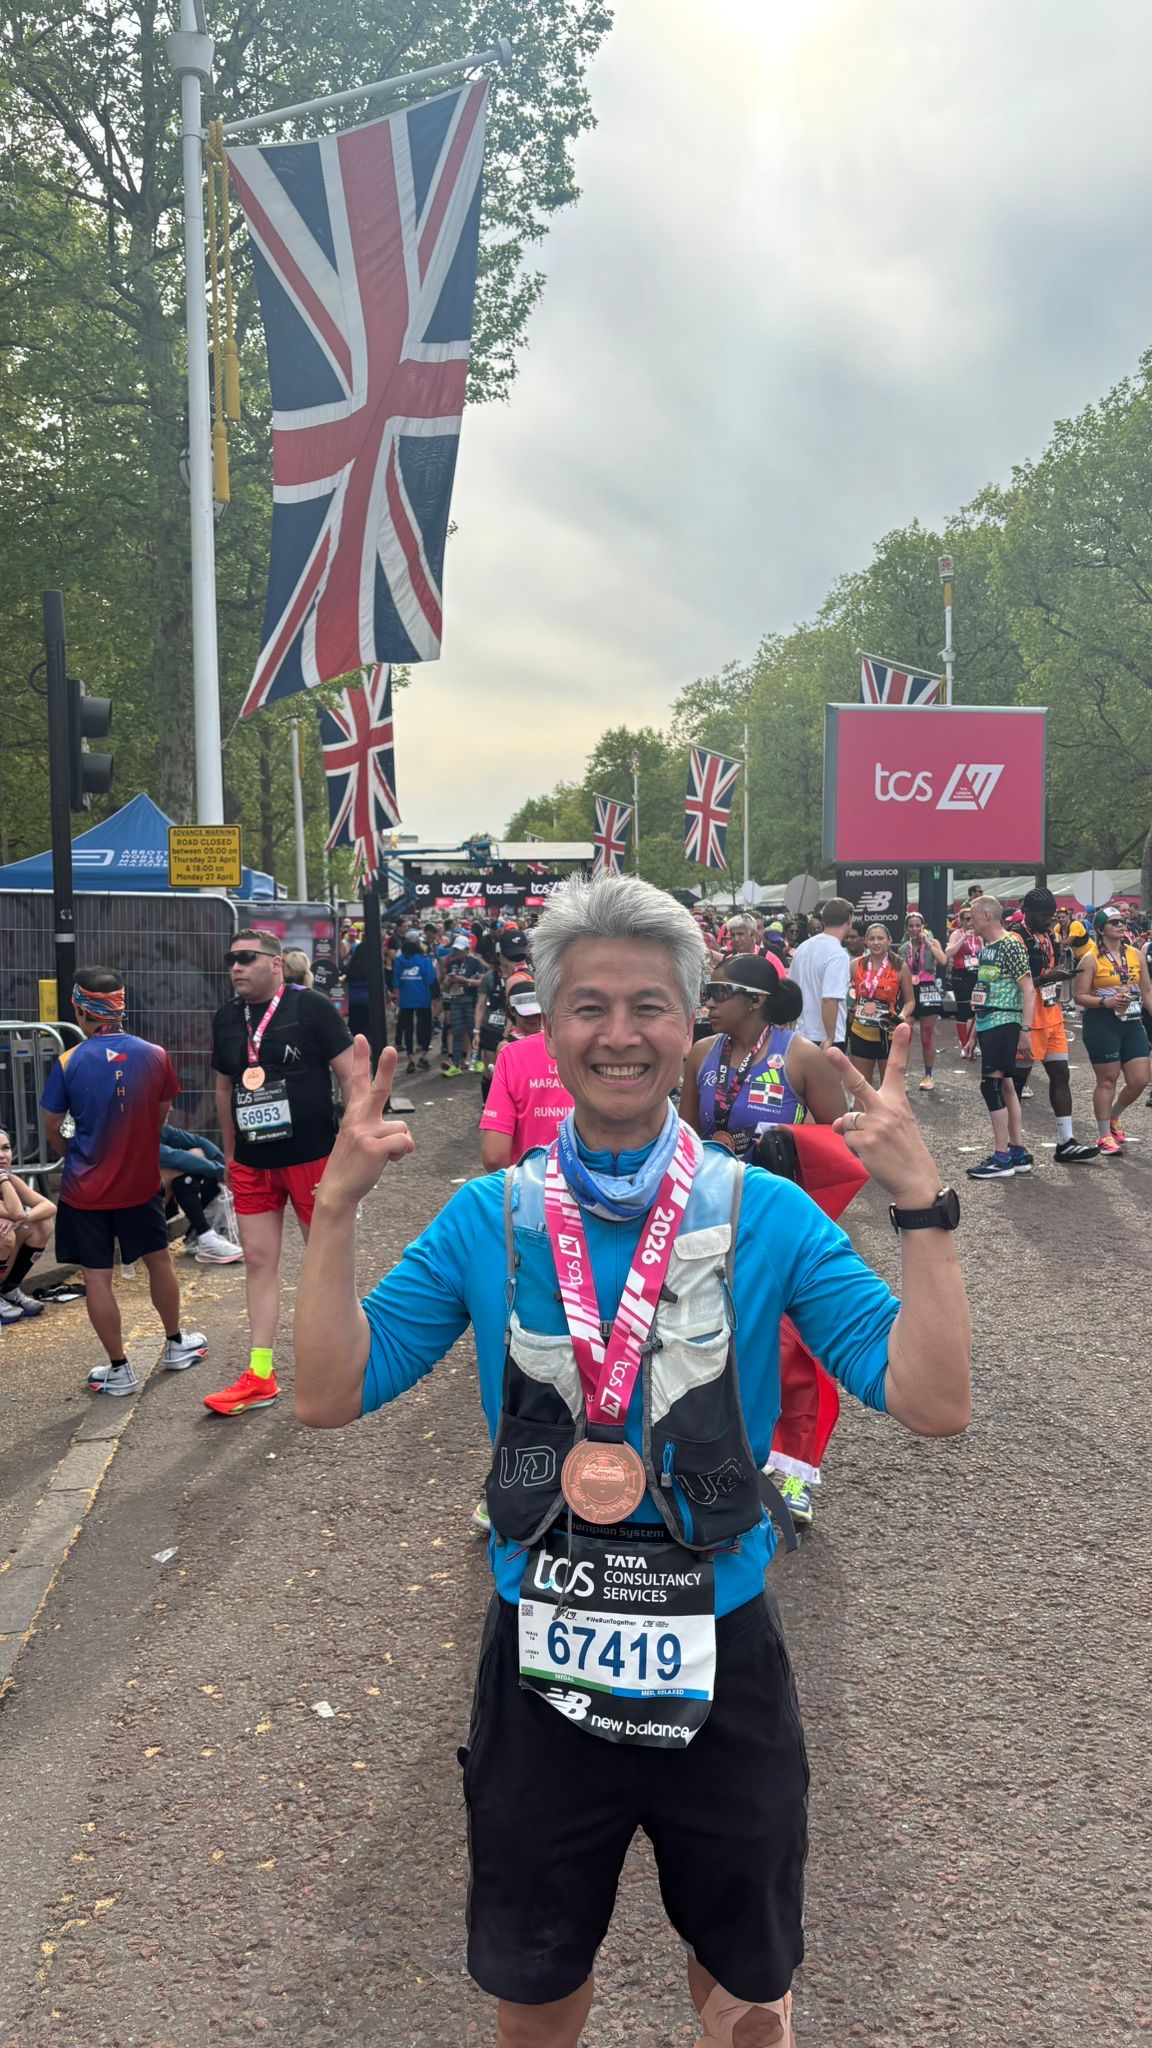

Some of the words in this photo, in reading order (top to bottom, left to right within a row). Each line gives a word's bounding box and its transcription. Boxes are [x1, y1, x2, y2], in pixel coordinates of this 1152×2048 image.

[875, 762, 933, 801] tcs
[176, 838, 199, 846] ROAD
[200, 838, 233, 846] CLOSED
[173, 856, 205, 864] Thursday
[218, 856, 237, 864] April
[176, 873, 204, 881] Monday
[216, 873, 234, 881] April
[415, 884, 430, 895] cs
[242, 1107, 281, 1127] 56953
[641, 1206, 676, 1266] 2026
[608, 1359, 632, 1388] tcs
[619, 1526, 664, 1539] System
[533, 1549, 595, 1598] tcs
[604, 1554, 648, 1569] TATA
[603, 1570, 702, 1587] CONSULTANCY
[602, 1587, 668, 1603] SERVICES
[586, 1615, 637, 1627] #WeRunTogether
[547, 1620, 682, 1682] 67419
[554, 1673, 575, 1683] MEDAL
[656, 1688, 685, 1696] RELAXED
[590, 1714, 624, 1733] new
[625, 1720, 690, 1739] balance
